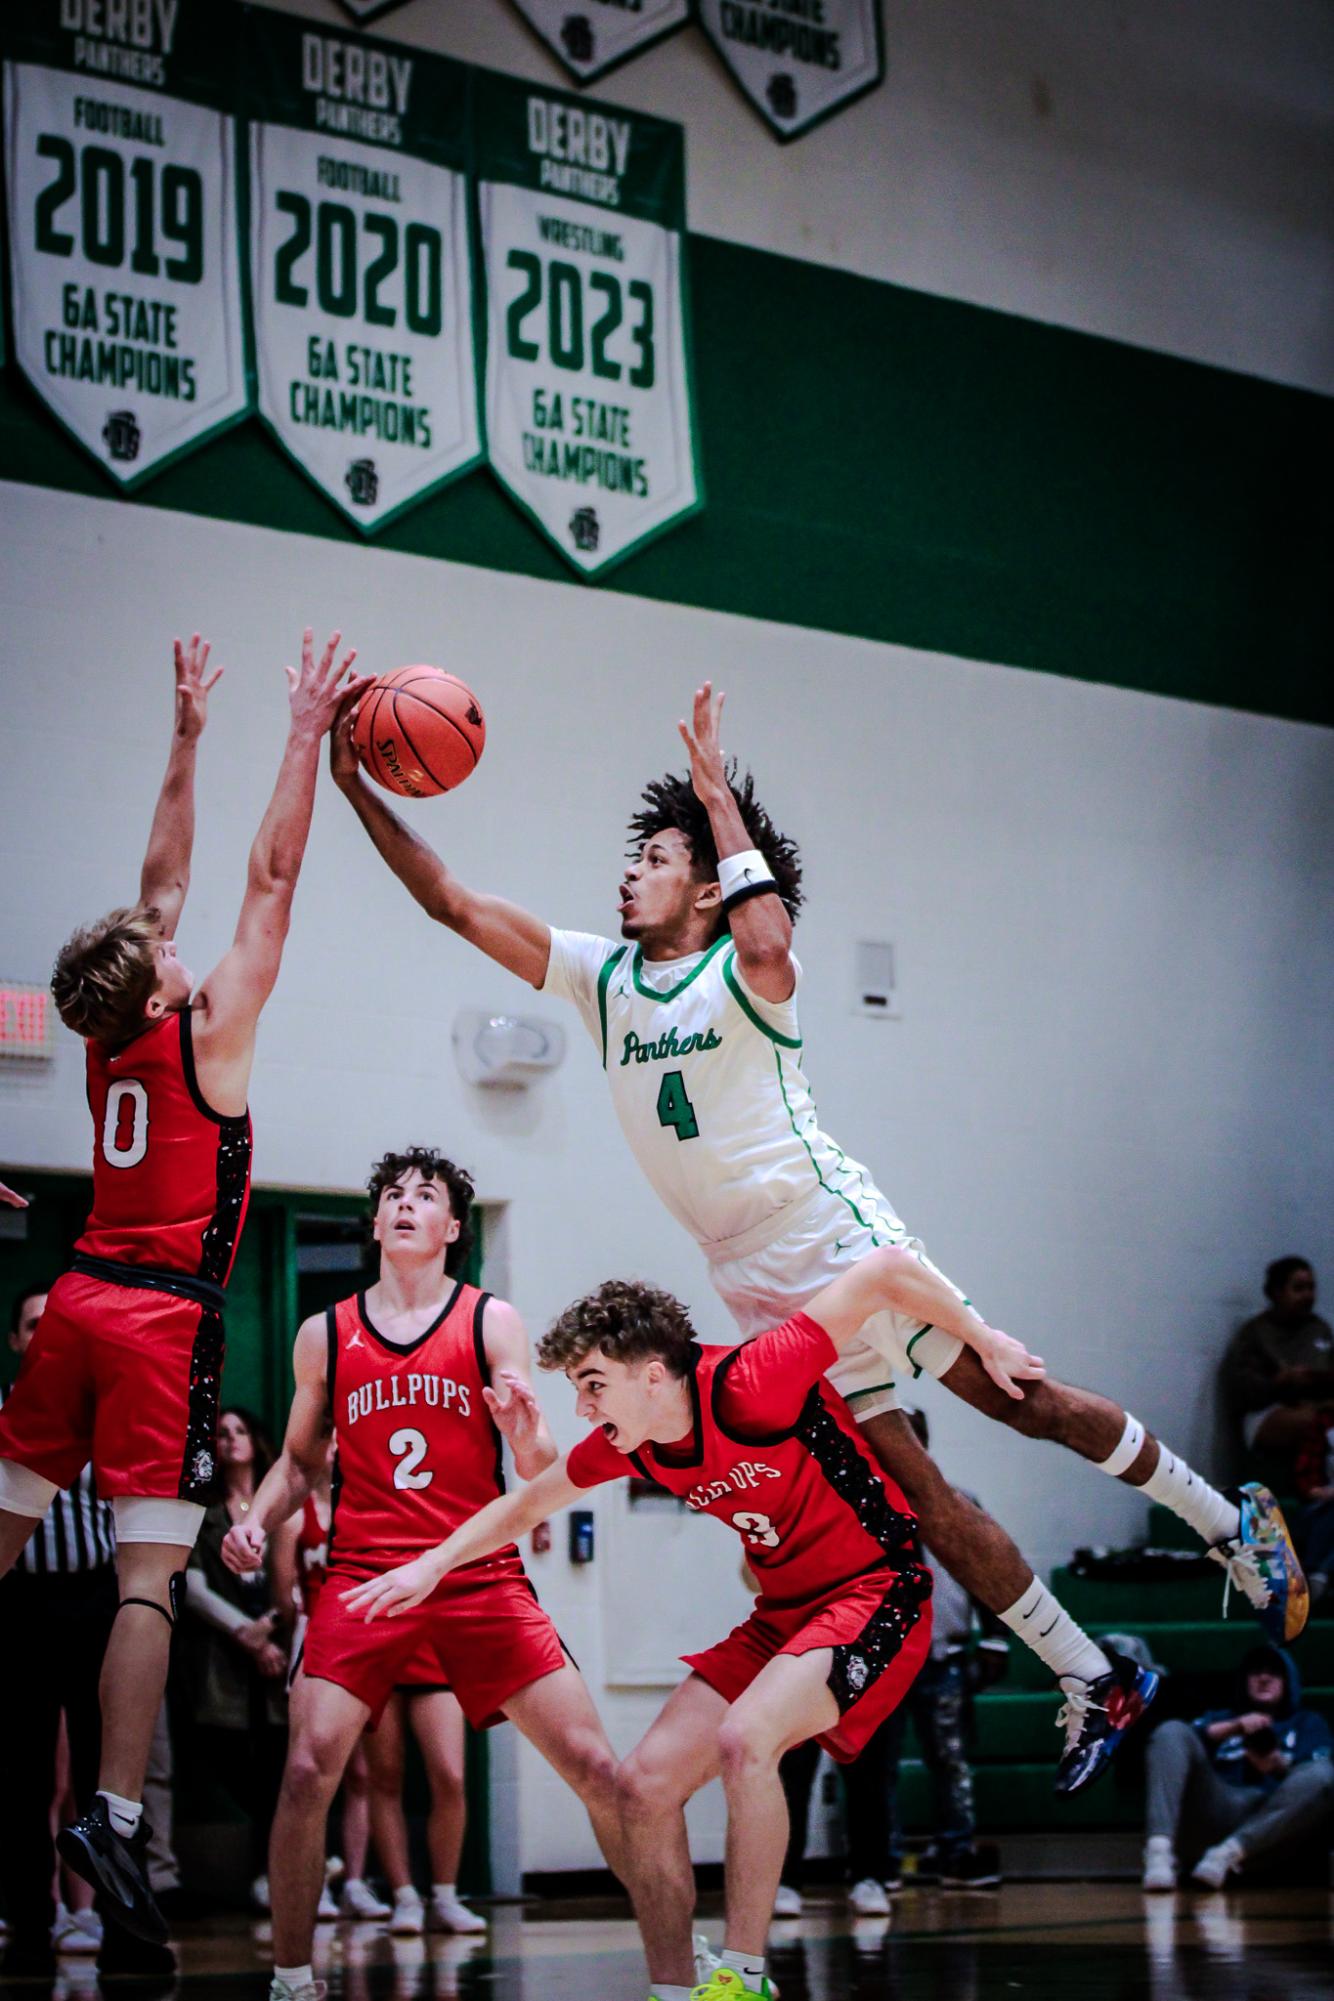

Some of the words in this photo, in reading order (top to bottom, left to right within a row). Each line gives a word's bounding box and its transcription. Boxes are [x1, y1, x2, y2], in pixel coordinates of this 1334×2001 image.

[60, 0, 178, 55] DERBY
[74, 36, 165, 86] PANTHERS
[302, 33, 413, 115] DERBY
[73, 96, 165, 147] FOOTBALL
[316, 98, 402, 145] PANTHERS
[528, 97, 631, 176] DERBY
[34, 133, 204, 286] 2019
[317, 154, 402, 204] FOOTBALL
[275, 190, 442, 338] 2020
[537, 212, 625, 263] WRESTLING
[62, 285, 98, 334] 6A
[104, 291, 177, 348] STATE
[506, 248, 655, 390] 2023
[44, 329, 196, 402] CHAMPIONS
[308, 335, 339, 382] 6A
[346, 344, 412, 398] STATE
[290, 380, 431, 449] CHAMPIONS
[533, 387, 564, 432] 6A
[571, 396, 630, 449] STATE
[521, 431, 649, 498] CHAMPIONS
[620, 1026, 722, 1066] Panthers
[102, 1078, 149, 1169] 0
[657, 1070, 700, 1142] 4
[347, 1373, 471, 1425] BULLPUPS
[388, 1428, 433, 1490] 2
[732, 1511, 780, 1547] 3
